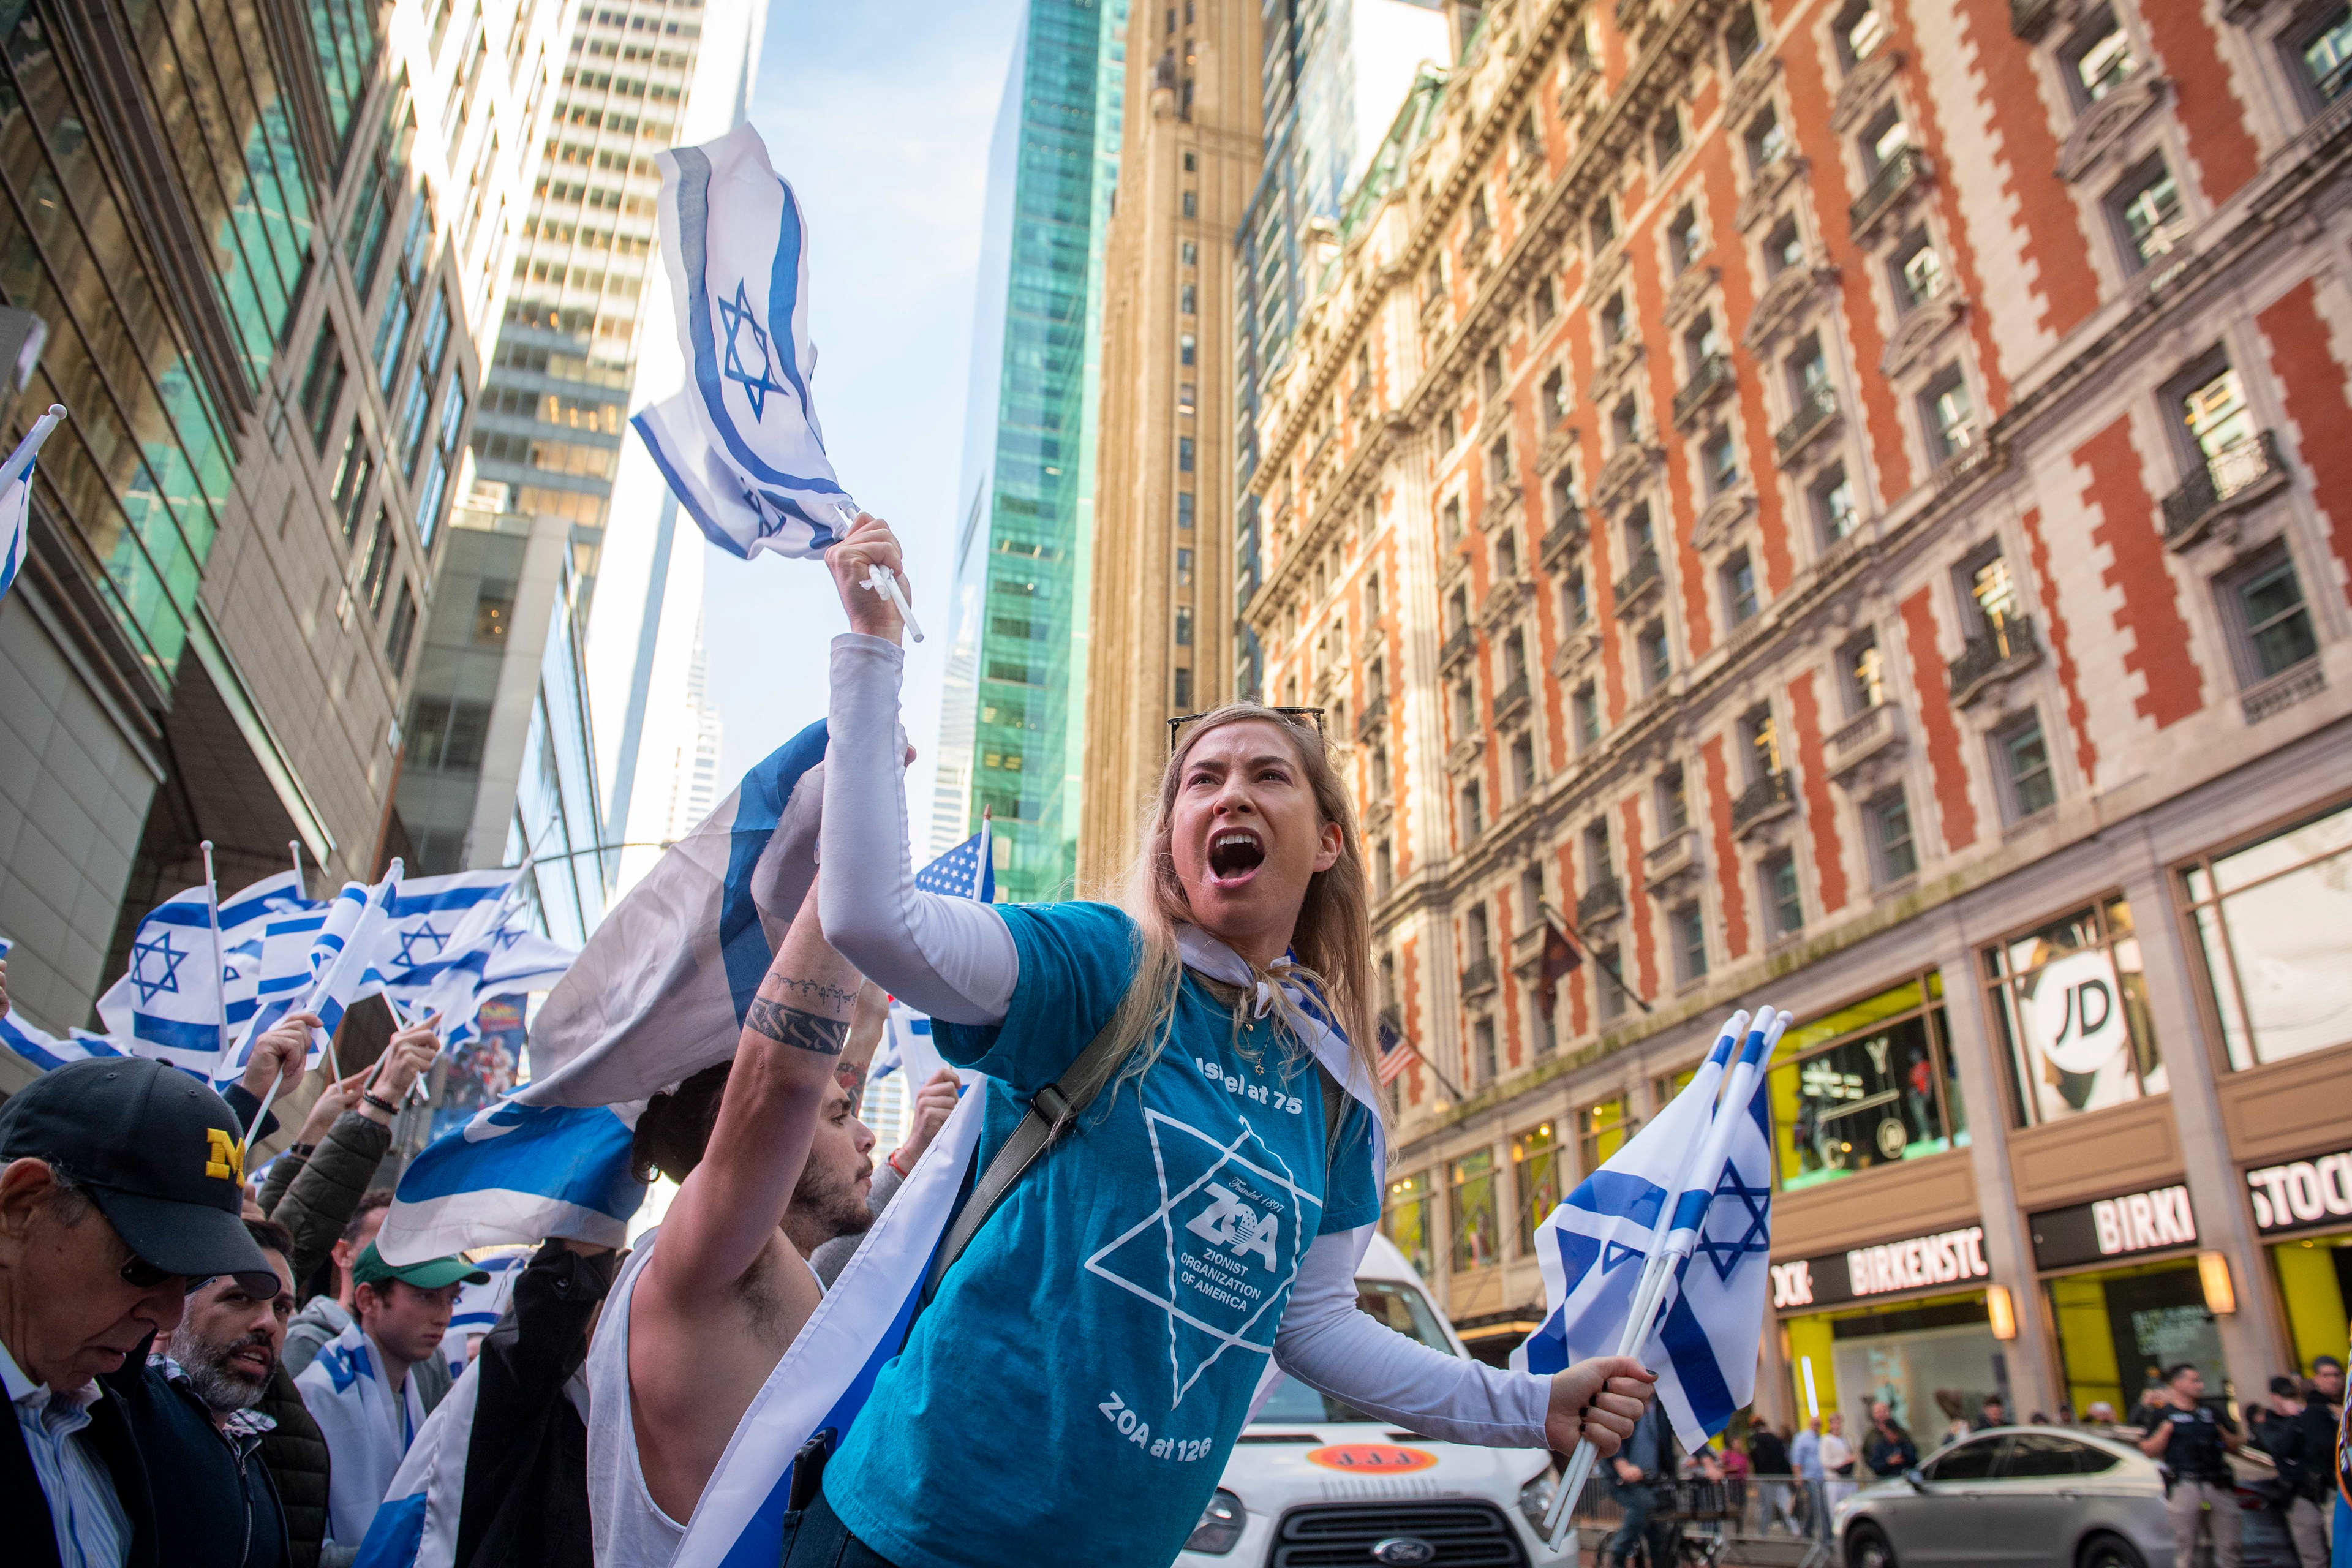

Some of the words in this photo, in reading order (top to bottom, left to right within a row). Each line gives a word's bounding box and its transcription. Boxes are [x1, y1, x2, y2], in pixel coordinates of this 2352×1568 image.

[2054, 979, 2110, 1047] JD
[1248, 1084, 1268, 1104] at
[1273, 1091, 1302, 1114] 75
[205, 1128, 245, 1189] M
[1229, 1177, 1263, 1201] Founded
[1261, 1197, 1285, 1213] 1897
[1185, 1182, 1278, 1273] ZOA
[1180, 1252, 1261, 1300] ORGANIZATION
[1202, 1248, 1248, 1276] ZIONIST
[1181, 1271, 1195, 1285] OF
[1194, 1280, 1247, 1312] AMERICA
[1098, 1390, 1149, 1449] ZOA
[1150, 1438, 1174, 1460] at
[1177, 1437, 1212, 1461] 126
